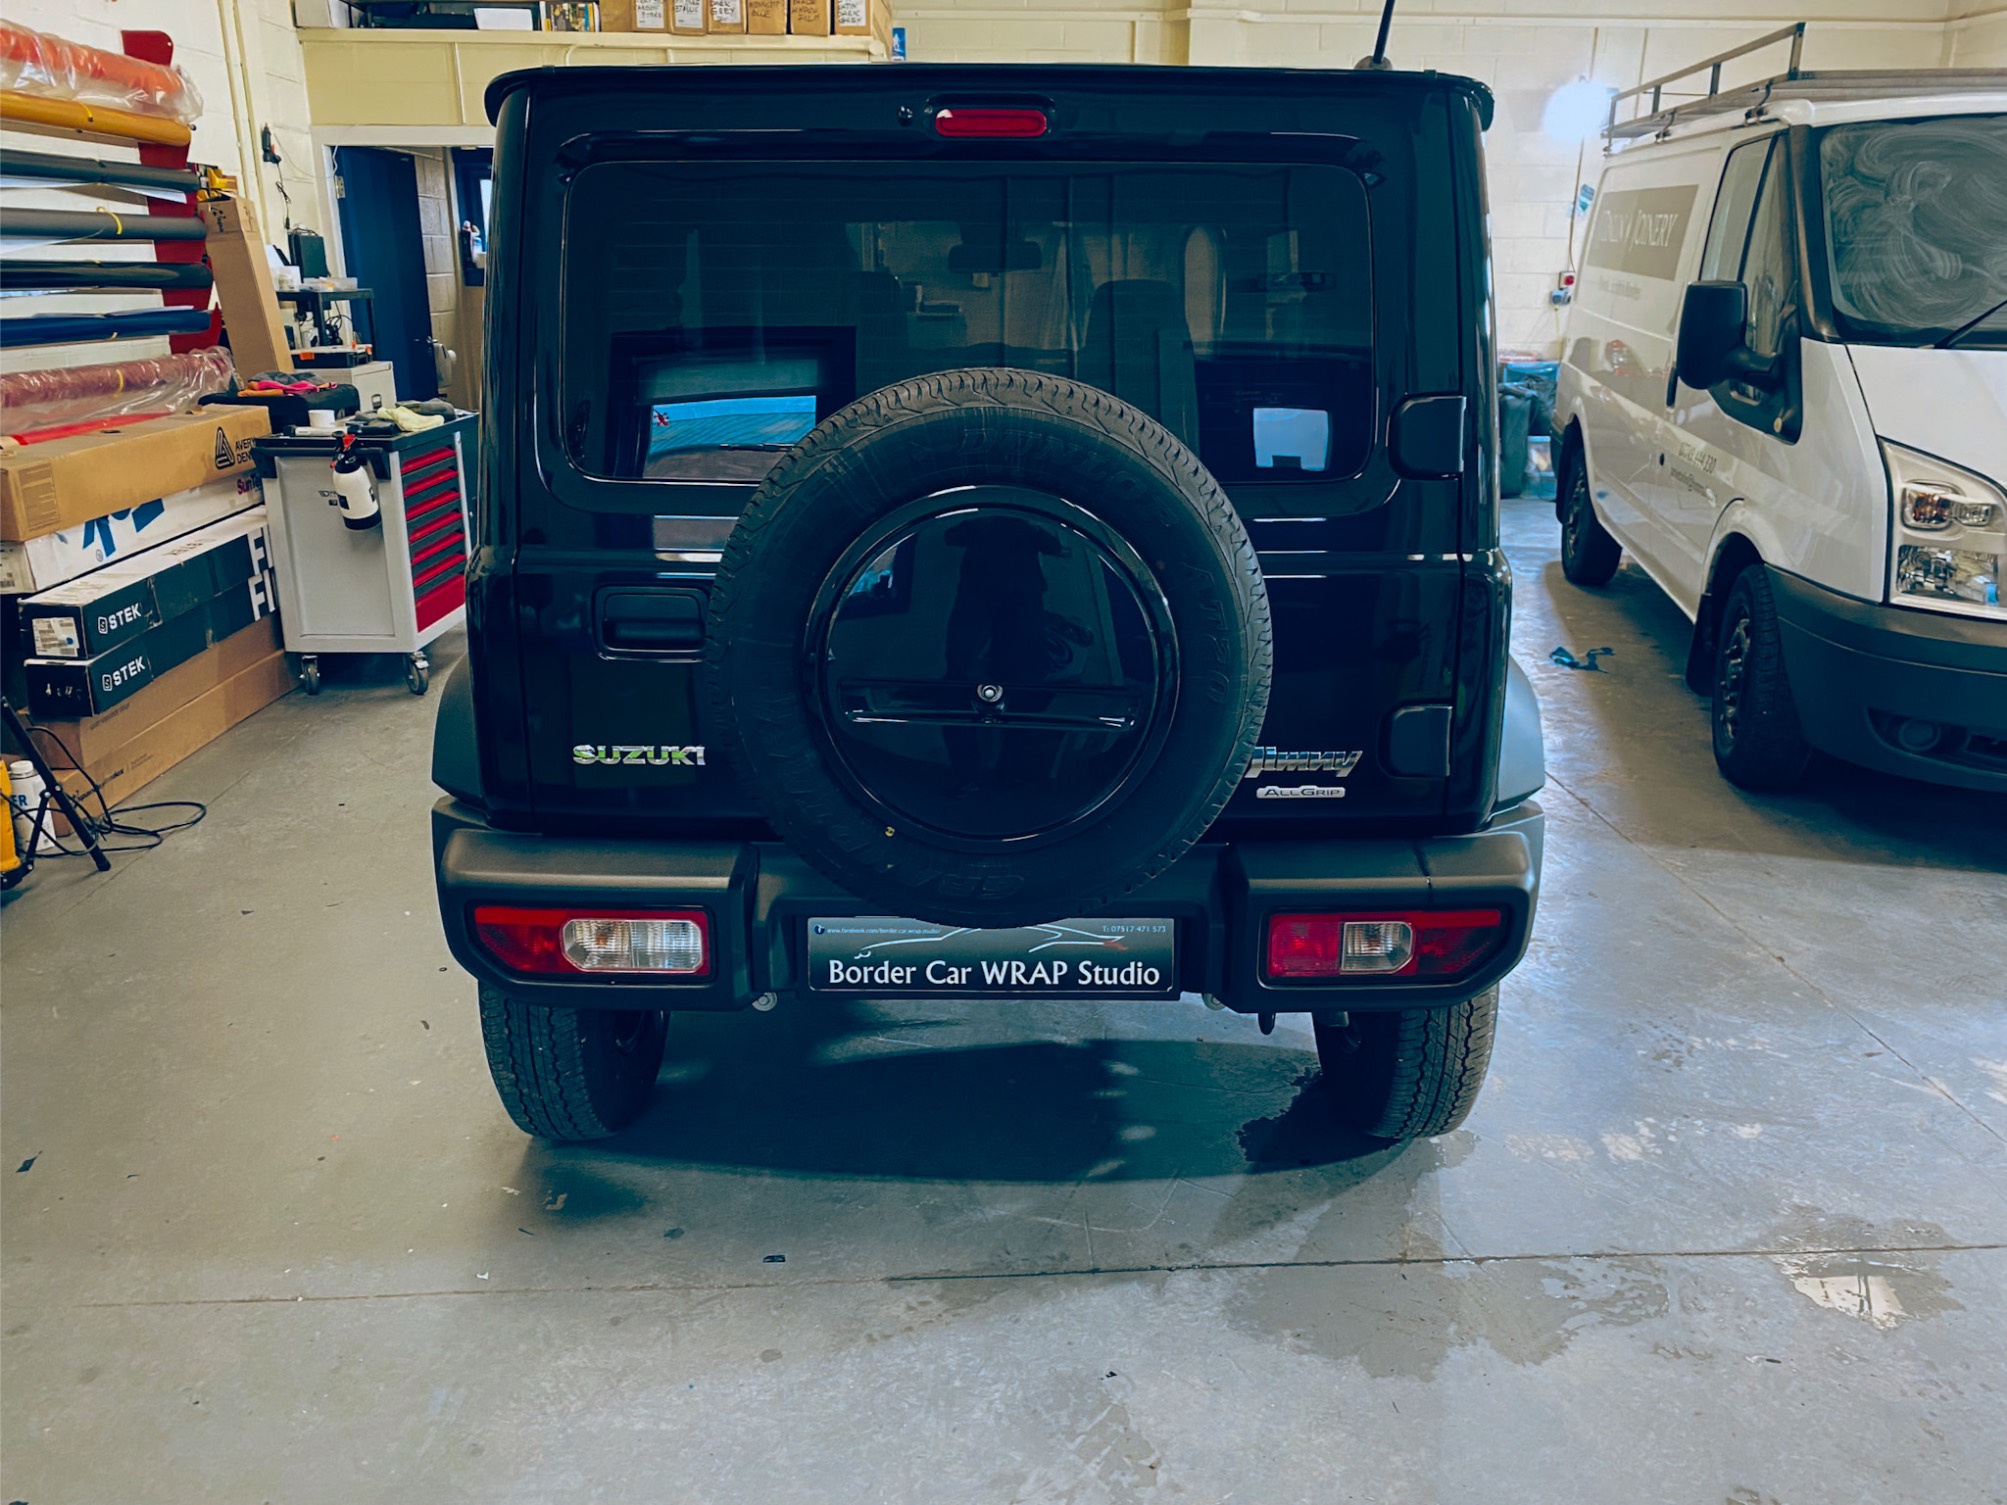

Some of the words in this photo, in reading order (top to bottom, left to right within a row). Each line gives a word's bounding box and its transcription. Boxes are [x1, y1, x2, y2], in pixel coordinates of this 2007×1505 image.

[108, 602, 142, 630] STEK
[112, 655, 146, 686] STEK
[572, 744, 706, 766] SUZUKI
[828, 959, 917, 985] Border
[925, 959, 973, 985] Car
[980, 960, 1070, 986] WRAP
[1077, 959, 1161, 986] Studio
